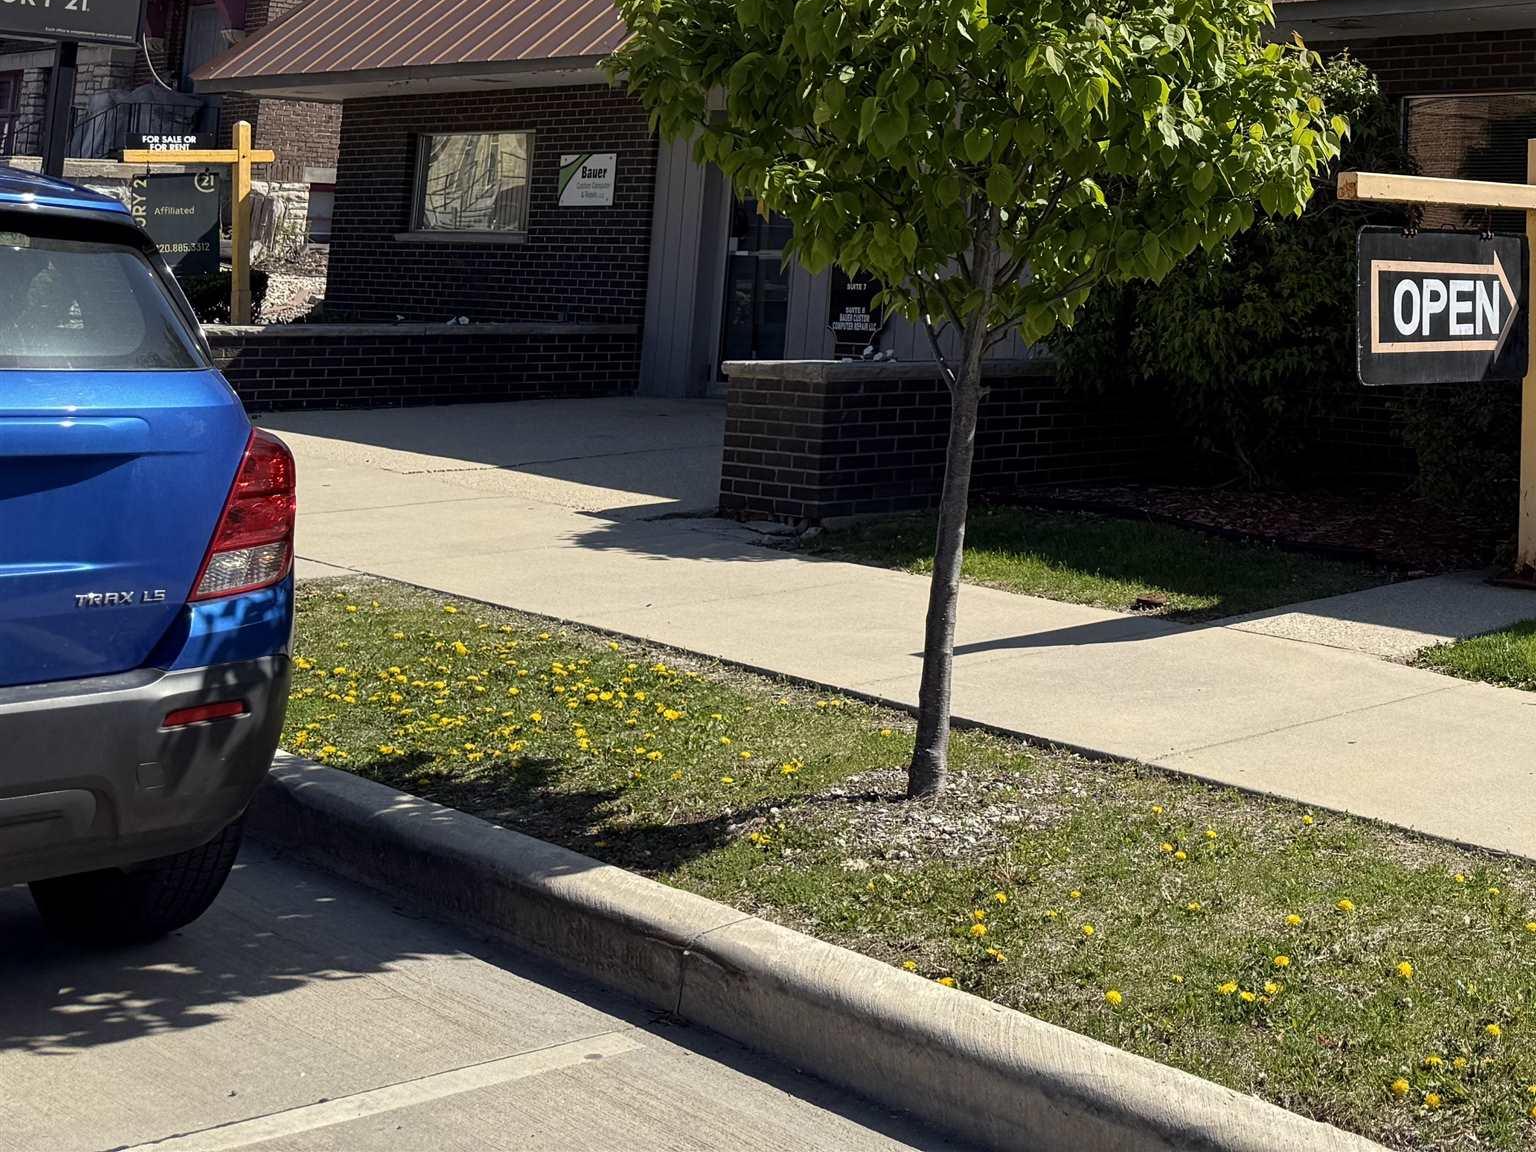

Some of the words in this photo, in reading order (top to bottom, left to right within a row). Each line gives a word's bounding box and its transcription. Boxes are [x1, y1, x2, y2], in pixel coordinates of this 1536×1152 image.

[581, 165, 608, 179] Bauer
[133, 178, 147, 189] 2
[154, 205, 195, 215] Affiliated
[156, 242, 210, 253] 20.885.3312
[1393, 278, 1500, 336] OPEN
[75, 592, 135, 607] TRAX
[143, 590, 166, 602] LS
